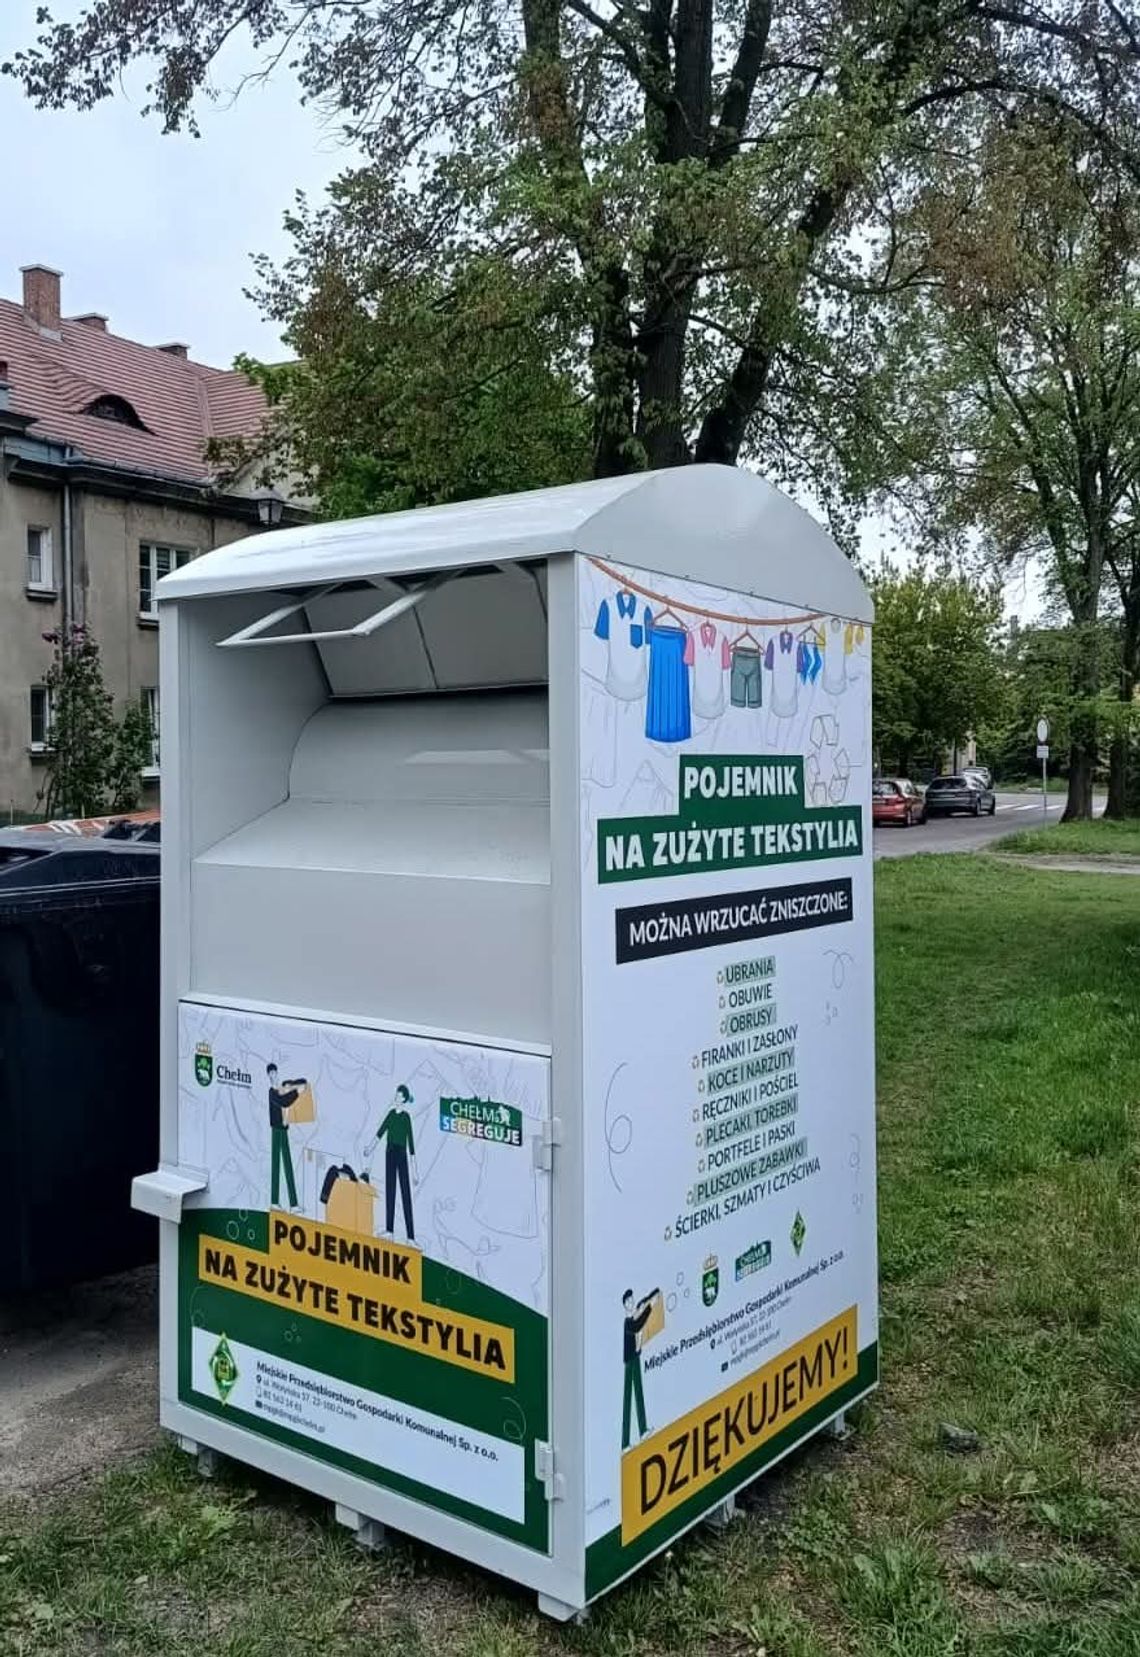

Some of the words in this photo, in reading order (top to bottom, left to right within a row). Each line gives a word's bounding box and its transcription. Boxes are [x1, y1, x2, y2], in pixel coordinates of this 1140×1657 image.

[684, 766, 798, 799] POJEMNIK
[605, 835, 645, 871] NA
[652, 821, 745, 866] ZUŻYTE
[751, 820, 859, 855] TEKSTYLIA
[629, 912, 692, 946] MOŻNA
[694, 896, 768, 934] WRZUCAĆ
[770, 891, 848, 922] ZNISZCZONE:
[726, 959, 774, 983] UBRANIA
[728, 983, 773, 1008] OBUWIE
[730, 1007, 773, 1033] OBRUSY
[701, 1041, 745, 1068] FIRANKI
[753, 1024, 799, 1052] ZASŁONY
[216, 1065, 252, 1083] Chełm
[708, 1068, 738, 1091] KOCE
[746, 1051, 794, 1079] NARZUTY
[703, 1087, 752, 1121] RĘCZNIKI
[760, 1073, 799, 1099] POŚCIEL
[755, 1099, 797, 1126] TOREBKI
[442, 1116, 520, 1144] SEGREGUJE
[708, 1135, 761, 1170] PORTFELE
[768, 1121, 795, 1144] PASKI
[697, 1165, 757, 1201] PLUSZOWE
[759, 1142, 803, 1174] ZABAWKI
[675, 1204, 721, 1238] ŚCIERKI,
[724, 1183, 766, 1215] SZMATY
[773, 1157, 821, 1192] CZYŚCIWA
[274, 1220, 411, 1284] POJEMNIK
[205, 1249, 238, 1281] NA
[245, 1261, 339, 1315] ZUŻYTE
[347, 1292, 506, 1371] TEKSTYLIA
[644, 1345, 679, 1373] Miejskie
[680, 1308, 745, 1351] Przedsiębiorstwo
[257, 1361, 288, 1381] Miejskie
[289, 1373, 355, 1407] Przedsiębiorstwo
[357, 1399, 403, 1425] Gospodarki
[405, 1416, 456, 1448] Komunalnej
[459, 1437, 472, 1452] Sp.
[481, 1449, 499, 1461] o.o.
[640, 1326, 848, 1515] DZIĘKUJEMY!
